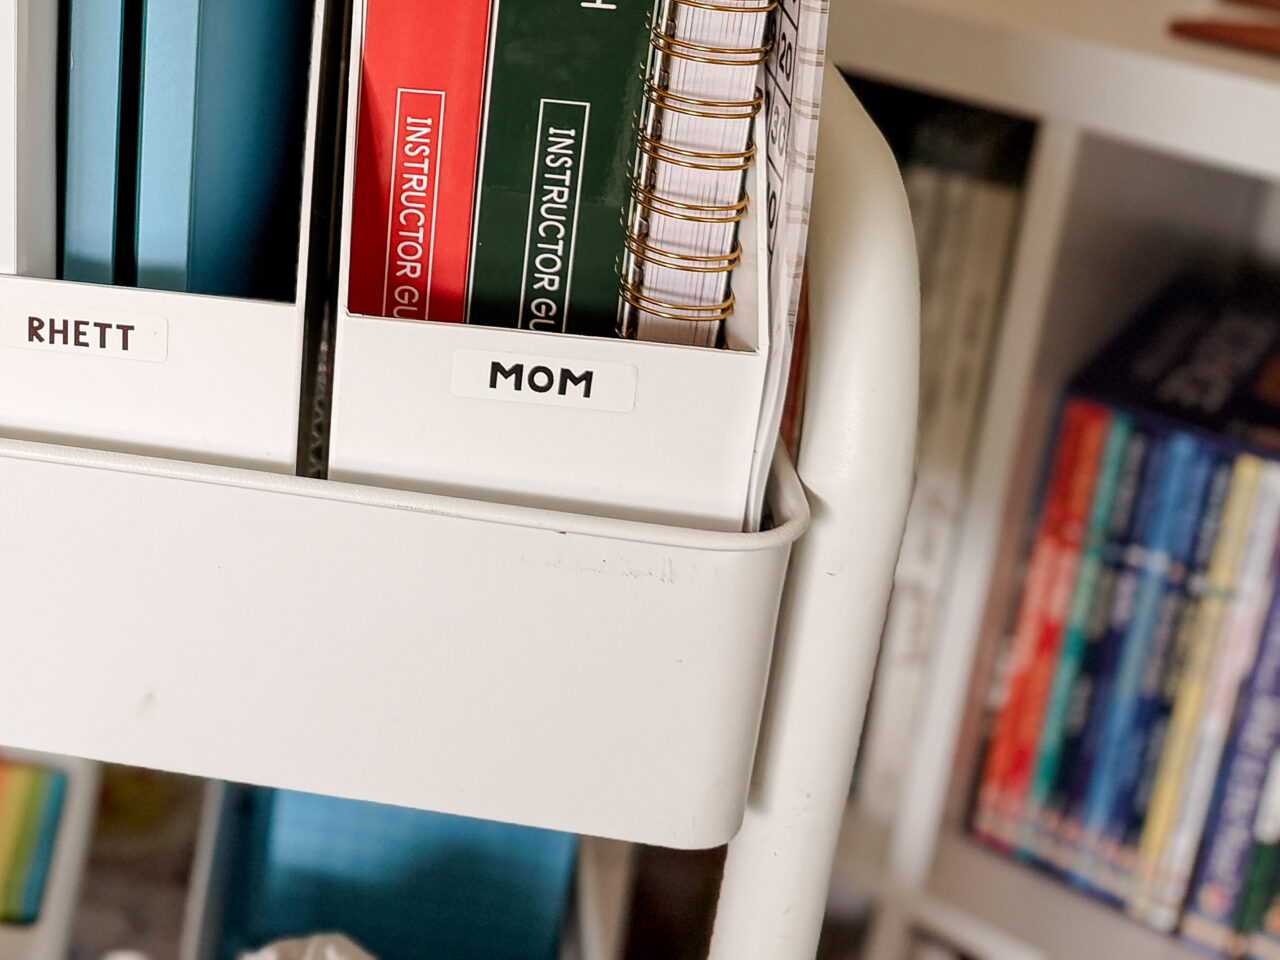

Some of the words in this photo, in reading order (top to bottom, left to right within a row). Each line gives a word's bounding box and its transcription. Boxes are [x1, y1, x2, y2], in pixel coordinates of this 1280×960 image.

[395, 115, 433, 279] INSTRUCTOR
[532, 126, 576, 291] INSTRUCTOR
[26, 315, 135, 352] RHETT
[488, 360, 594, 399] MOM
